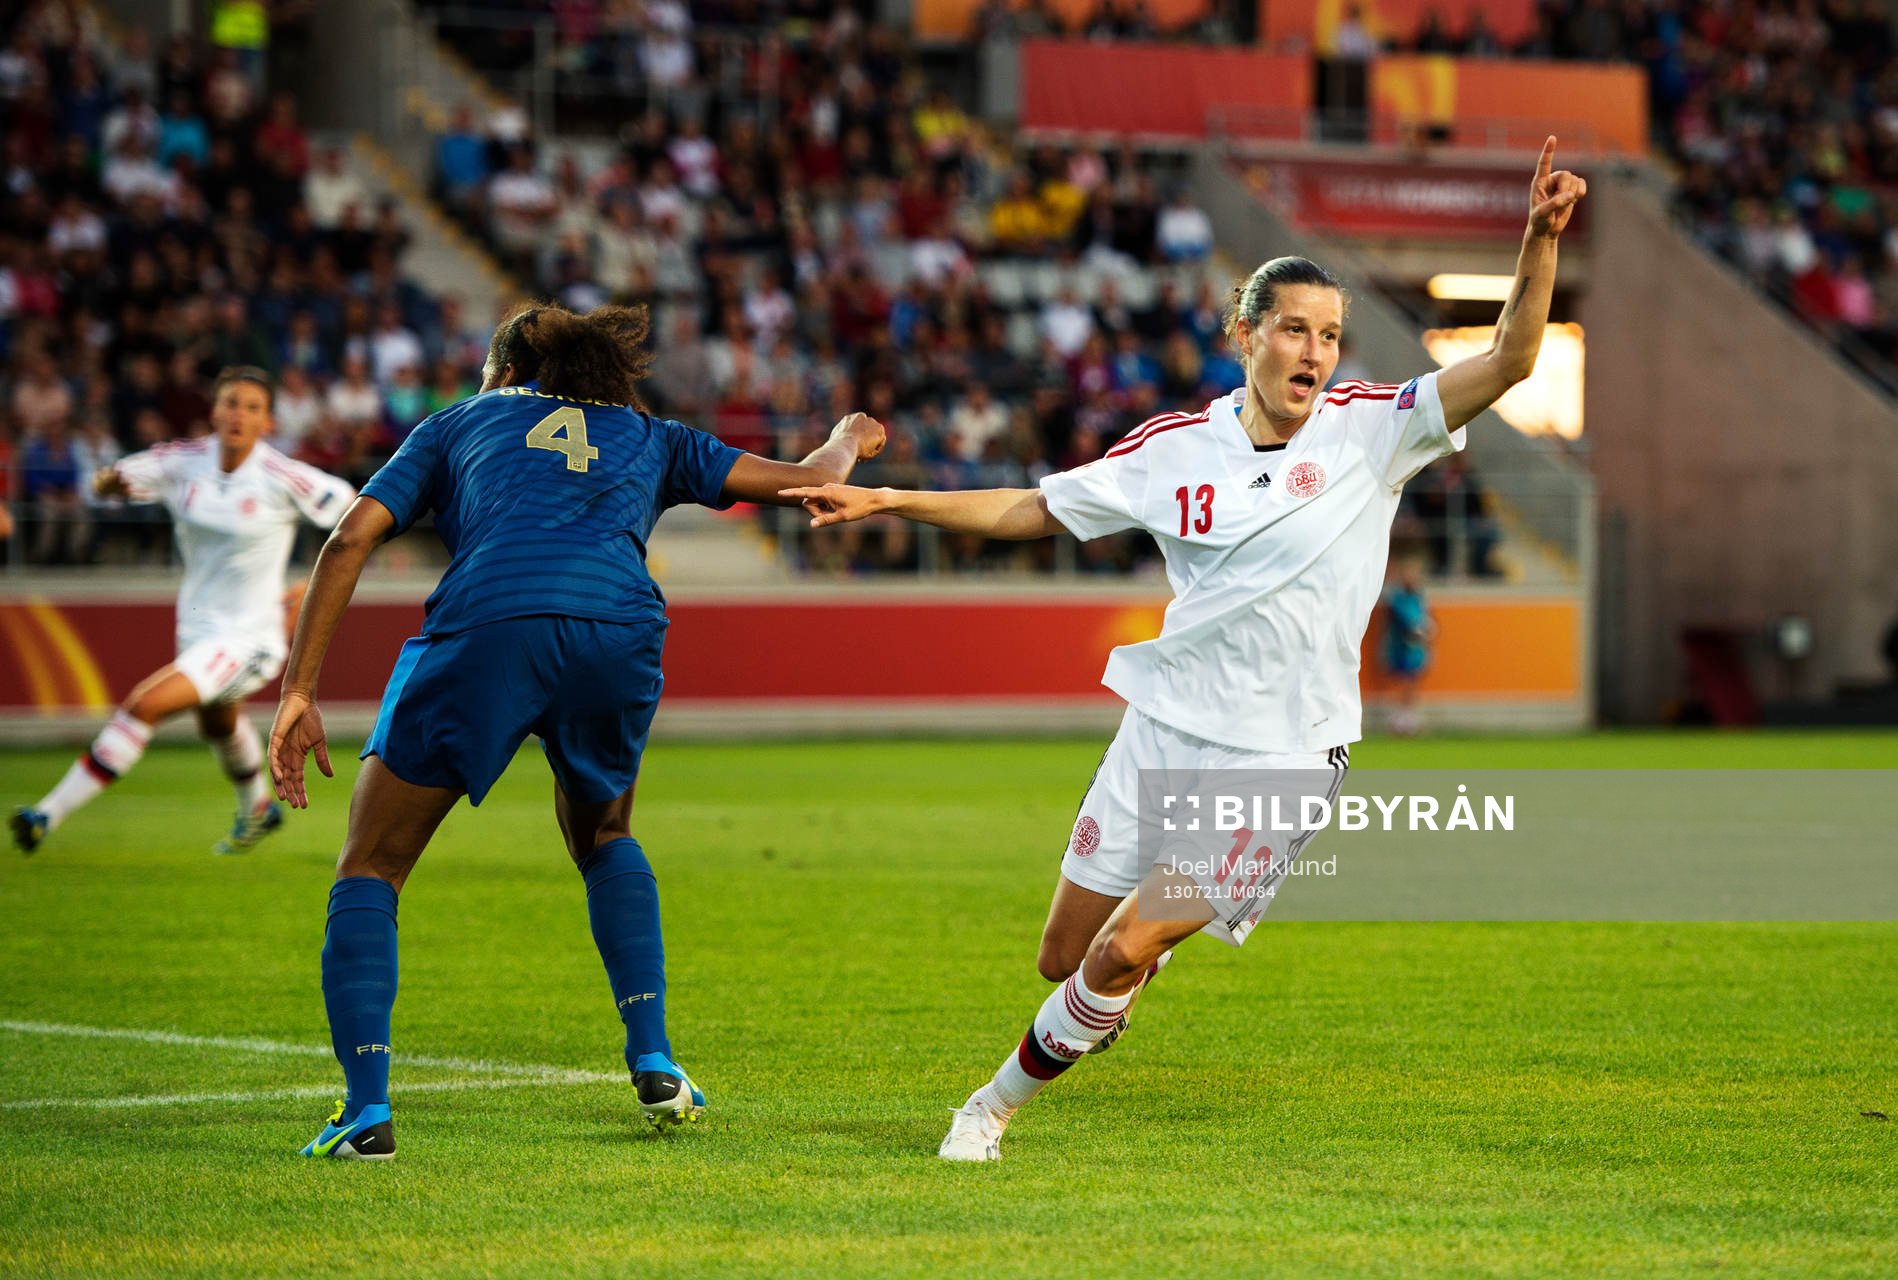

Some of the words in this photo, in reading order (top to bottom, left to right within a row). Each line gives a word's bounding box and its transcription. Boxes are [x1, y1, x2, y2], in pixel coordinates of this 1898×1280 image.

[526, 406, 598, 473] 4
[1176, 484, 1215, 537] 13
[619, 993, 657, 1008] FFF
